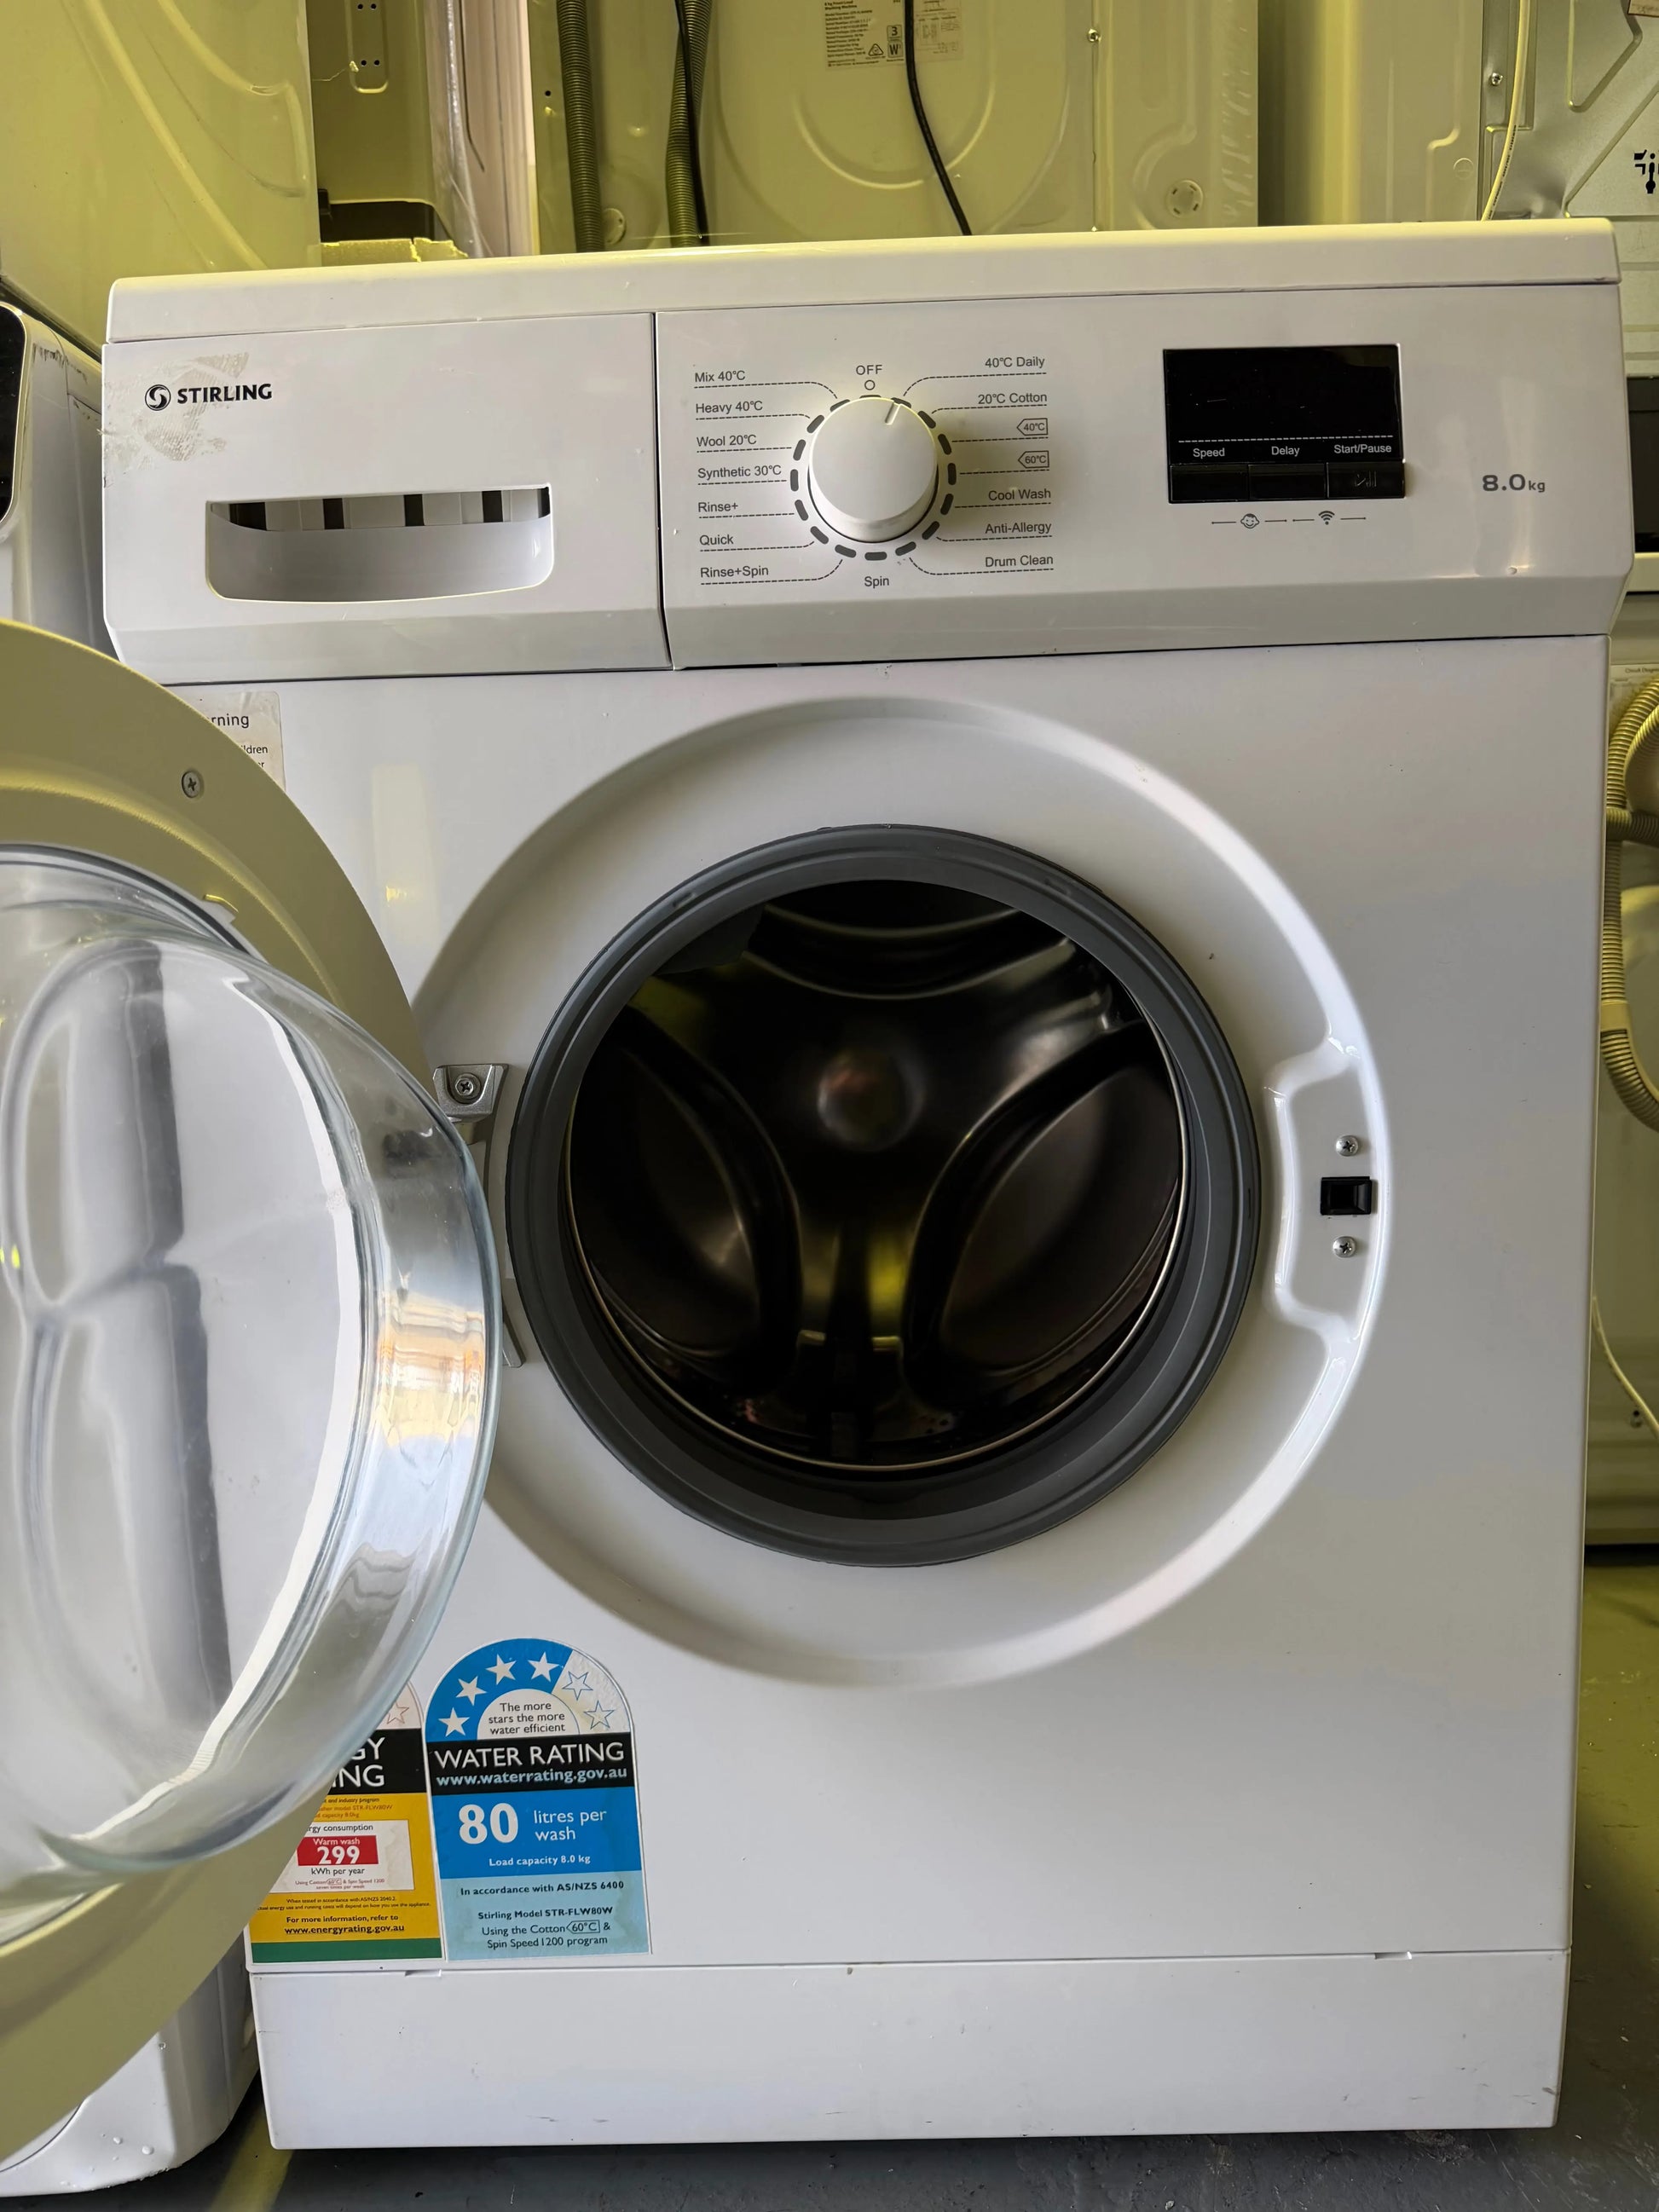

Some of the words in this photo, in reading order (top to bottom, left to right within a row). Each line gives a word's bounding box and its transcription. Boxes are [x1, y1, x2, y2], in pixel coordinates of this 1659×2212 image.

[1016, 356, 1045, 369] Daily
[855, 364, 883, 375] OFF
[695, 372, 714, 382] Mix
[176, 383, 272, 404] STIRLING
[1009, 393, 1047, 403] Cotton
[696, 403, 732, 414] Heavy
[697, 436, 725, 447] Wool
[1193, 448, 1225, 459] Speed
[1271, 446, 1300, 457] Delay
[1333, 443, 1392, 454] Start/Pause
[697, 466, 751, 480] Synthetic
[988, 490, 1015, 500] Cool
[1018, 488, 1051, 500] Wash
[698, 502, 739, 512] Rinse+
[985, 523, 1052, 534] Anti-Allergy
[699, 534, 735, 546] Quick
[986, 557, 1016, 568] Drum
[1020, 555, 1054, 565] Clean
[700, 565, 769, 578] Rinse+Spin
[864, 575, 890, 589] Spin
[211, 713, 250, 729] rning
[500, 1702, 521, 1712] The
[523, 1702, 552, 1711] more
[488, 1715, 513, 1724] stars
[517, 1713, 534, 1723] the
[537, 1712, 565, 1722] more
[490, 1724, 520, 1735] water
[523, 1723, 566, 1733] efficient
[434, 1747, 523, 1769] WATER
[529, 1741, 625, 1766] RATING
[436, 1767, 627, 1787] www.waterrating.gov.au
[459, 1802, 519, 1845] 80
[533, 1810, 575, 1824] litres
[580, 1810, 607, 1826] per
[307, 1825, 321, 1834] rgy
[324, 1824, 373, 1833] consumption
[535, 1826, 575, 1841] wash
[340, 1837, 361, 1845] wash
[317, 1845, 360, 1865] 299
[489, 1857, 514, 1867] Load
[517, 1855, 558, 1866] capacity
[560, 1855, 575, 1863] 8.0
[578, 1854, 591, 1864] kg
[460, 1887, 471, 1896] In
[473, 1886, 529, 1895] accordance
[557, 1882, 598, 1891] AS/NZS
[600, 1880, 624, 1890] 6400
[323, 1915, 369, 1923] information,
[477, 1910, 512, 1920] Stirling
[514, 1909, 543, 1918] Model
[545, 1906, 614, 1917] STR-FLW80W
[284, 1924, 405, 1935] www.energyrating.gov.au
[482, 1926, 508, 1937] Using
[512, 1926, 527, 1934] the
[530, 1924, 565, 1933] Cotton
[571, 1921, 597, 1932] 60°C
[603, 1921, 610, 1931] &
[487, 1939, 507, 1950] Spin
[510, 1938, 540, 1949] Speed
[541, 1937, 564, 1947] 1200
[567, 1936, 608, 1947] program
